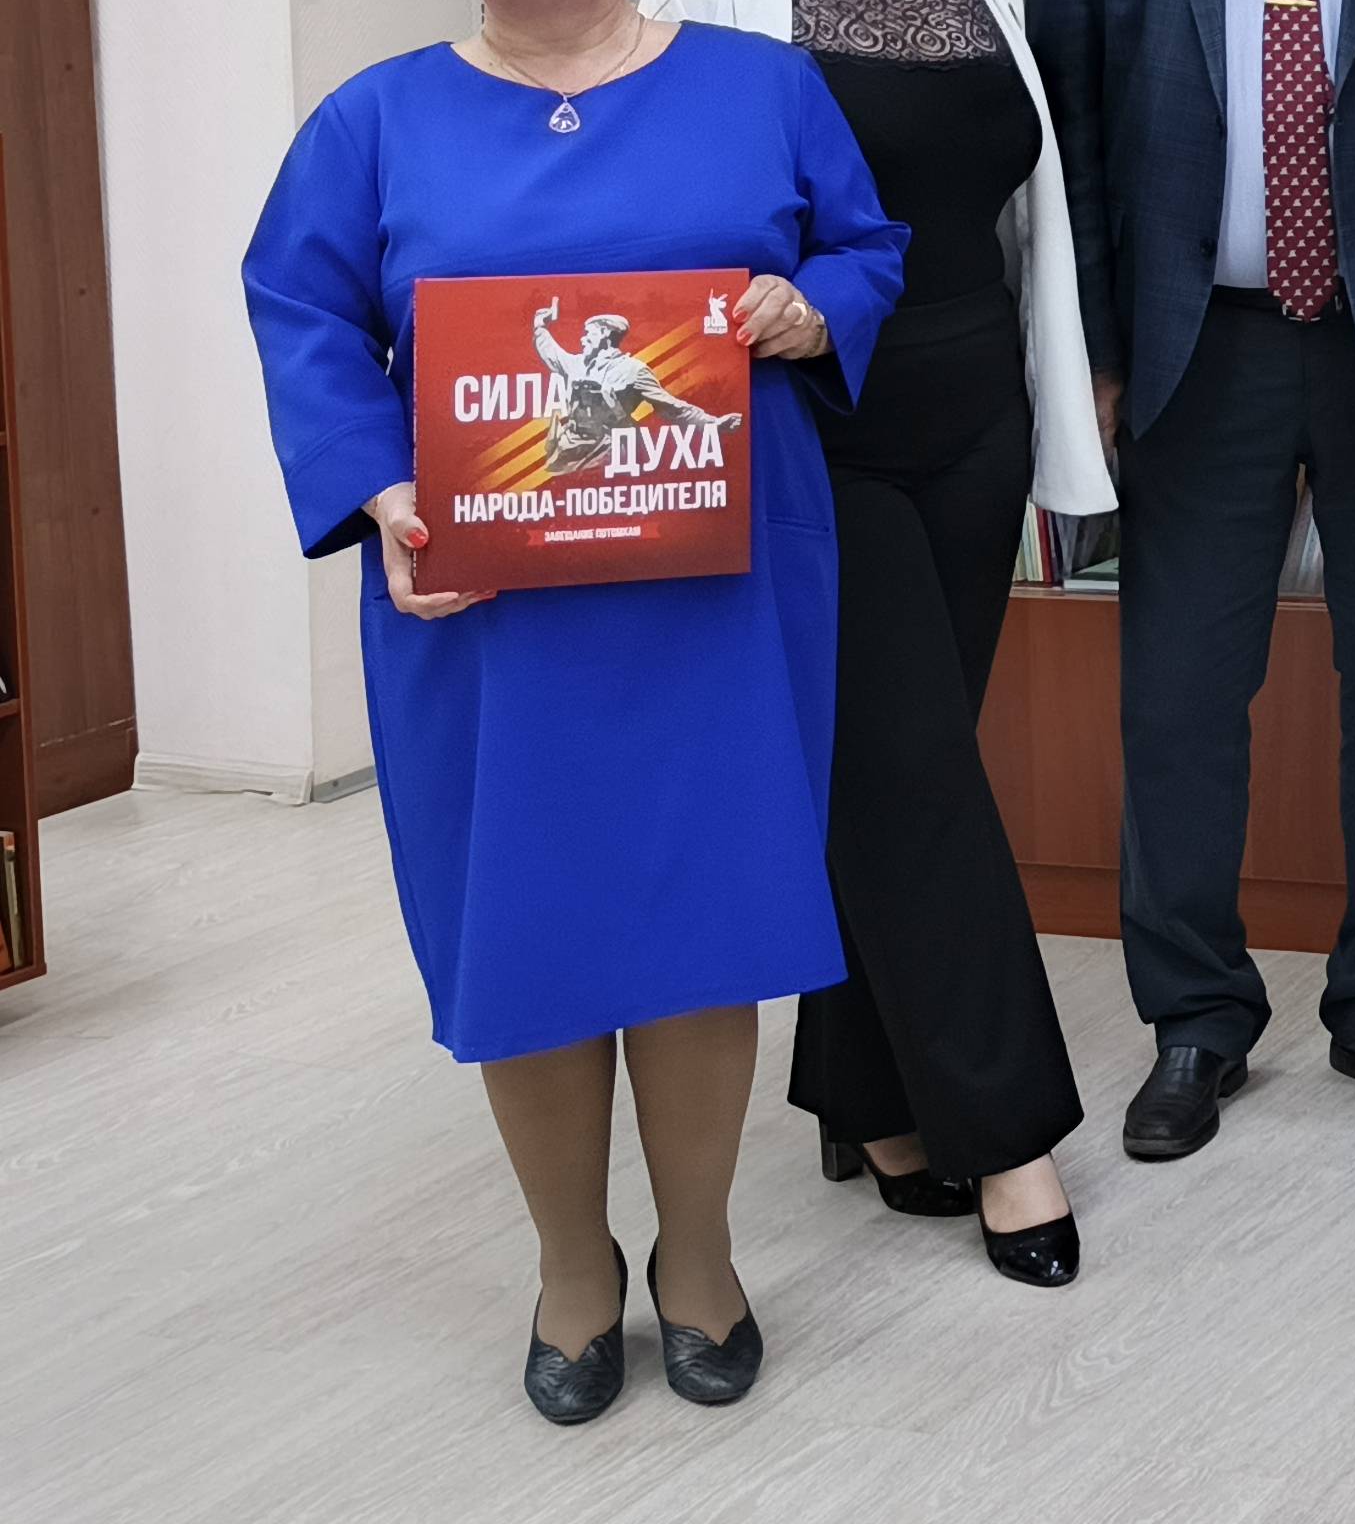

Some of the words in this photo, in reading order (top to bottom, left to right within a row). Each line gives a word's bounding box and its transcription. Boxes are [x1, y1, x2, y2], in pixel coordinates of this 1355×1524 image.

[454, 372, 573, 423] СИЛА
[604, 424, 724, 479] ДУХА
[454, 480, 727, 523] НАРОДА-ПОБЕДИТЕЛЯ
